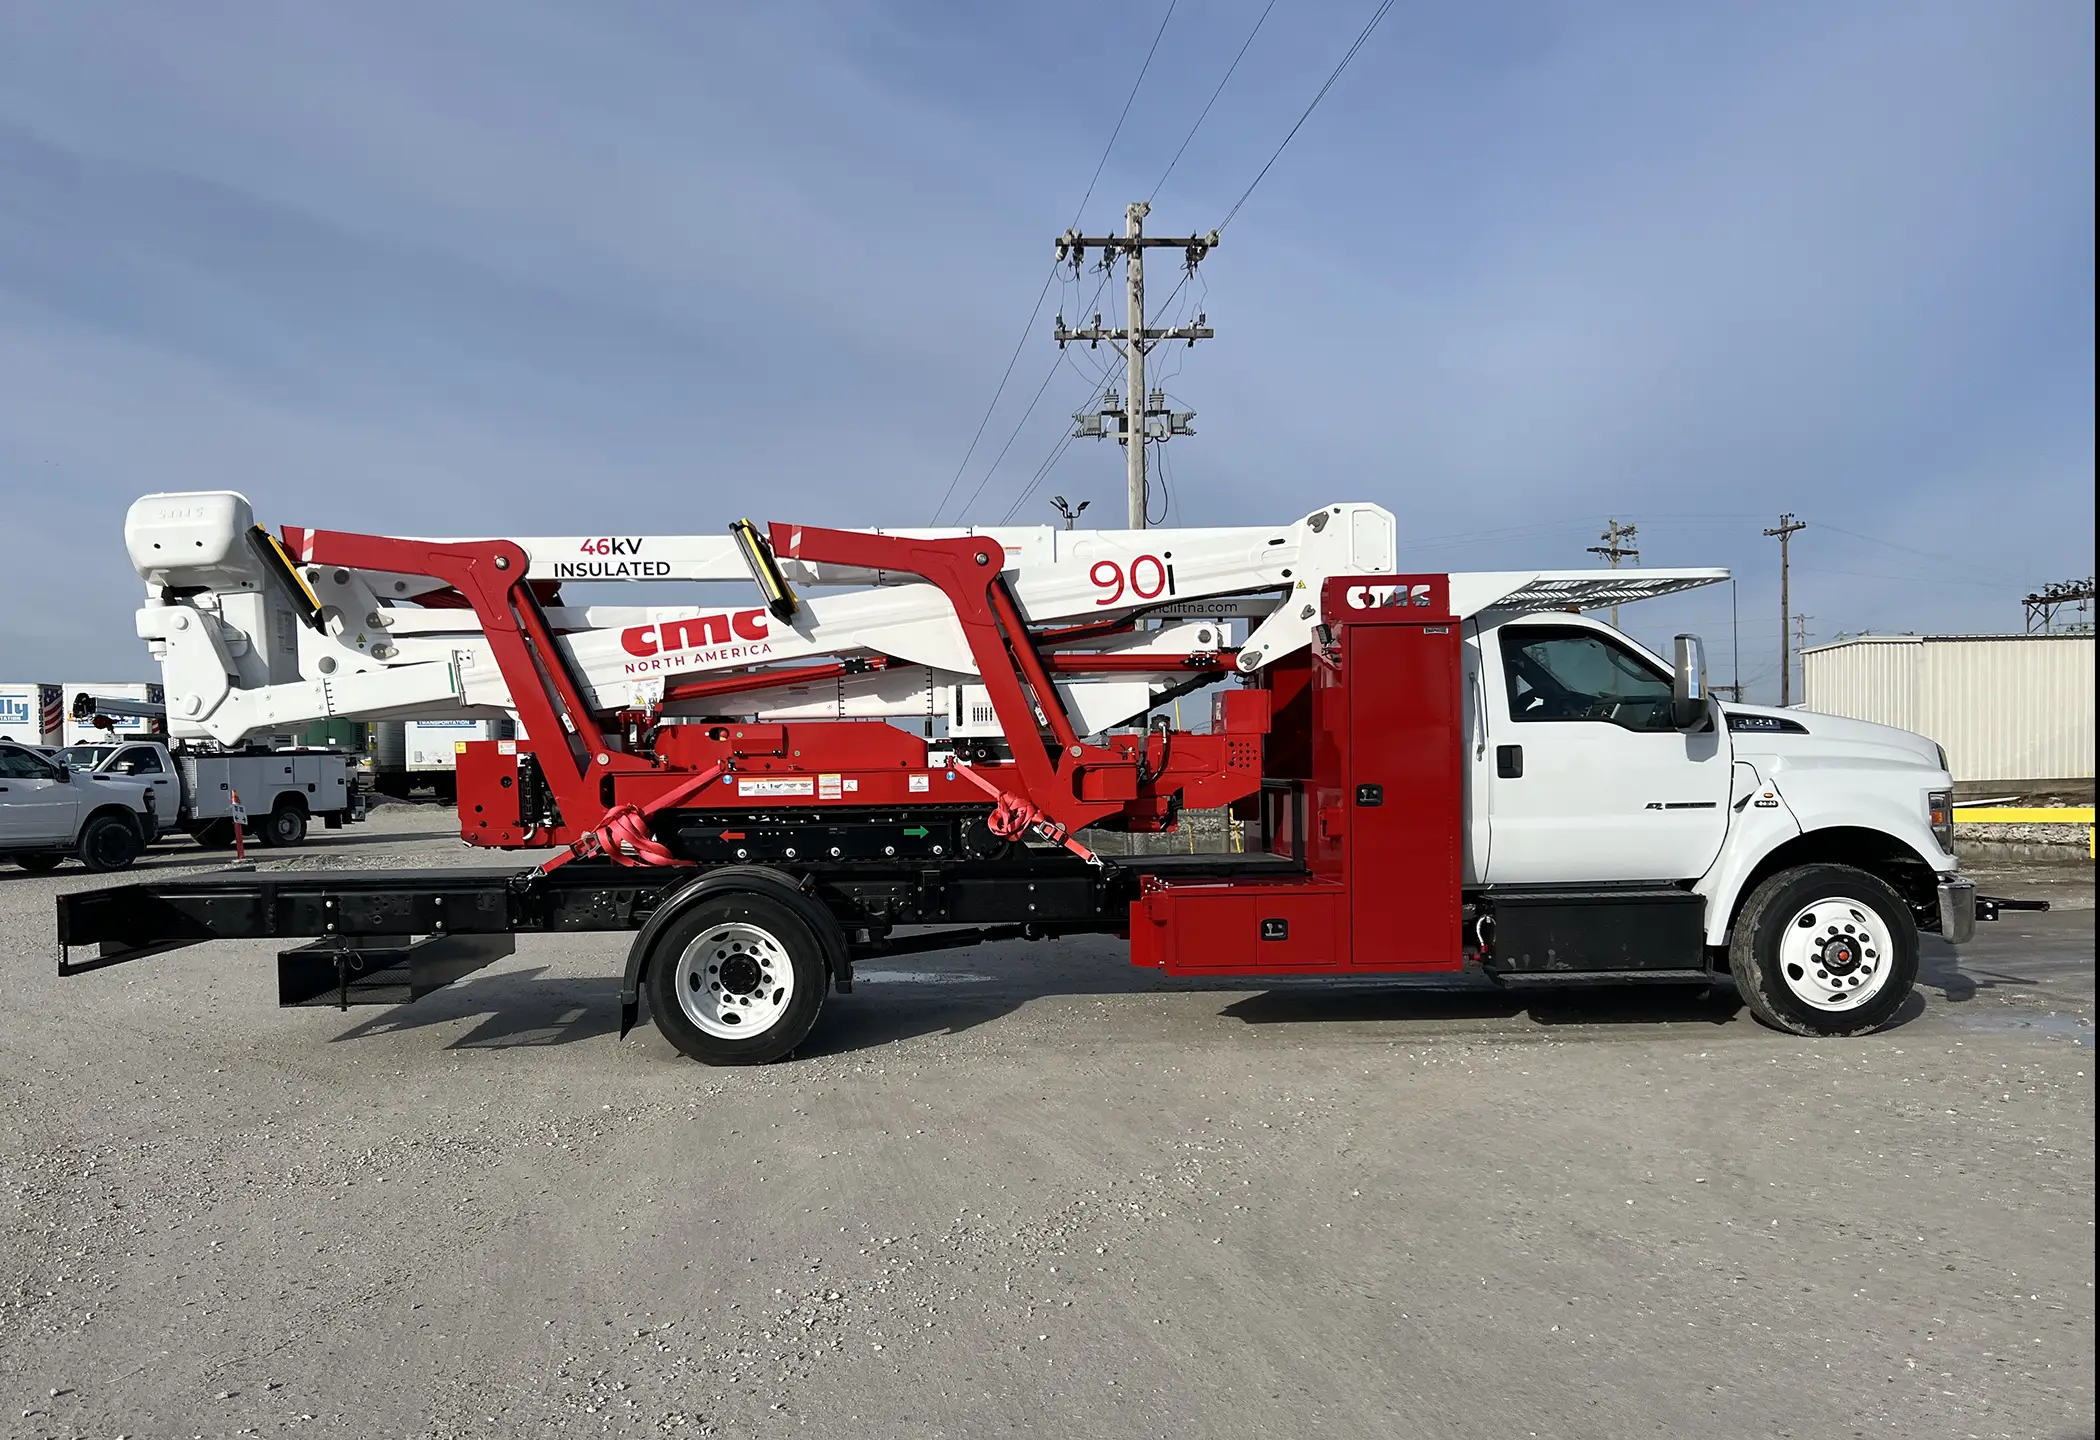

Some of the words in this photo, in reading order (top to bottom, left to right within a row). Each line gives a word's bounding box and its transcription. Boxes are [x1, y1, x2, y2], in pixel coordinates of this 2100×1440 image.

[580, 538, 642, 555] 46kV
[554, 561, 671, 577] INSULATED
[1090, 551, 1176, 605] 90i
[625, 655, 685, 674] NORTH
[694, 643, 772, 664] AMERICA
